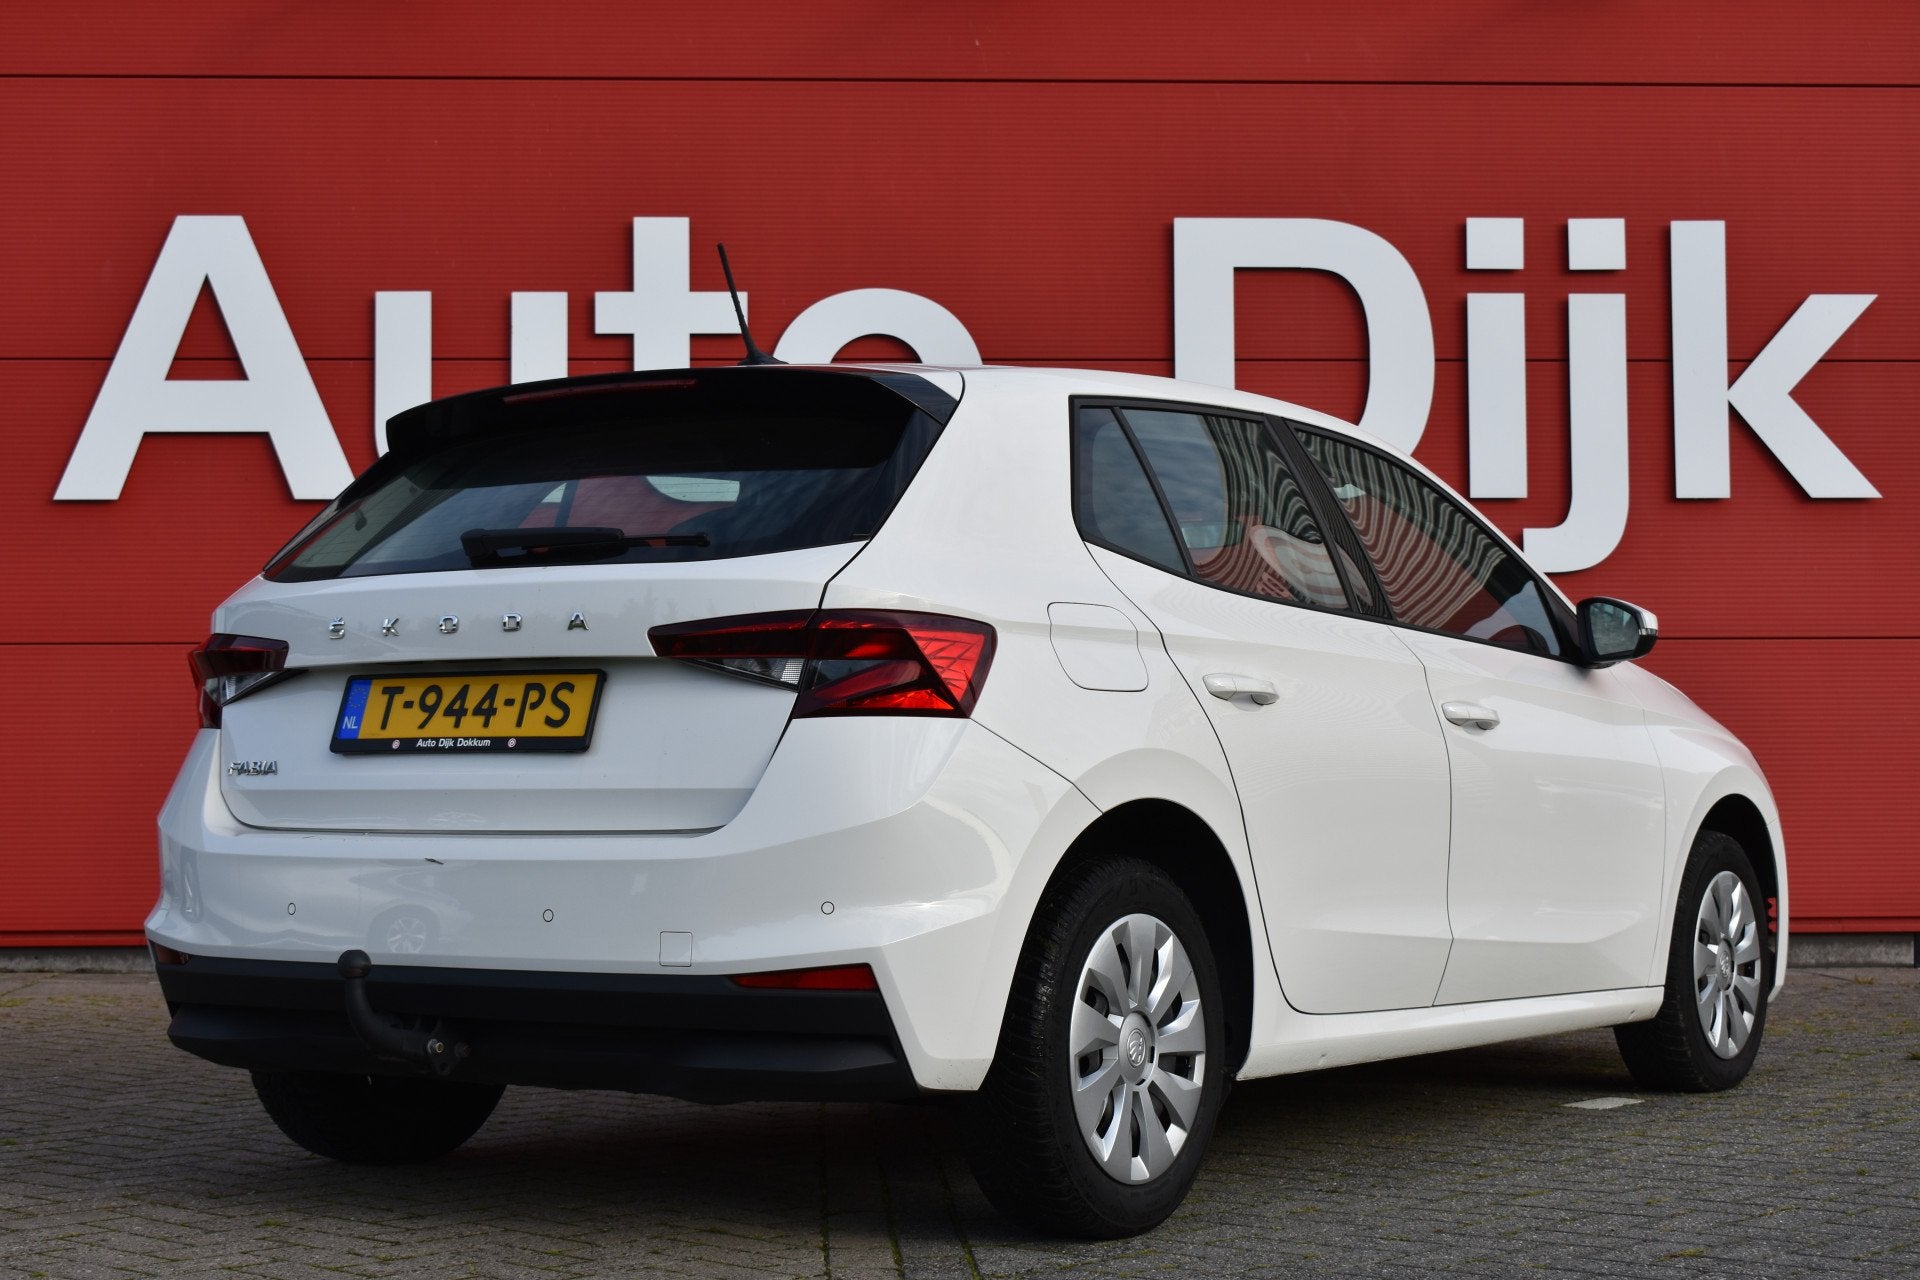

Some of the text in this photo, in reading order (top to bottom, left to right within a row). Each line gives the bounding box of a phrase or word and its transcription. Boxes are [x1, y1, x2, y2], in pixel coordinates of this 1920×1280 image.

[1173, 217, 1883, 573] Dijk
[380, 682, 576, 730] T-944-PS
[342, 716, 358, 730] NL
[416, 738, 491, 749] Auto Dijk Dokkum
[228, 760, 278, 775] FABIA
